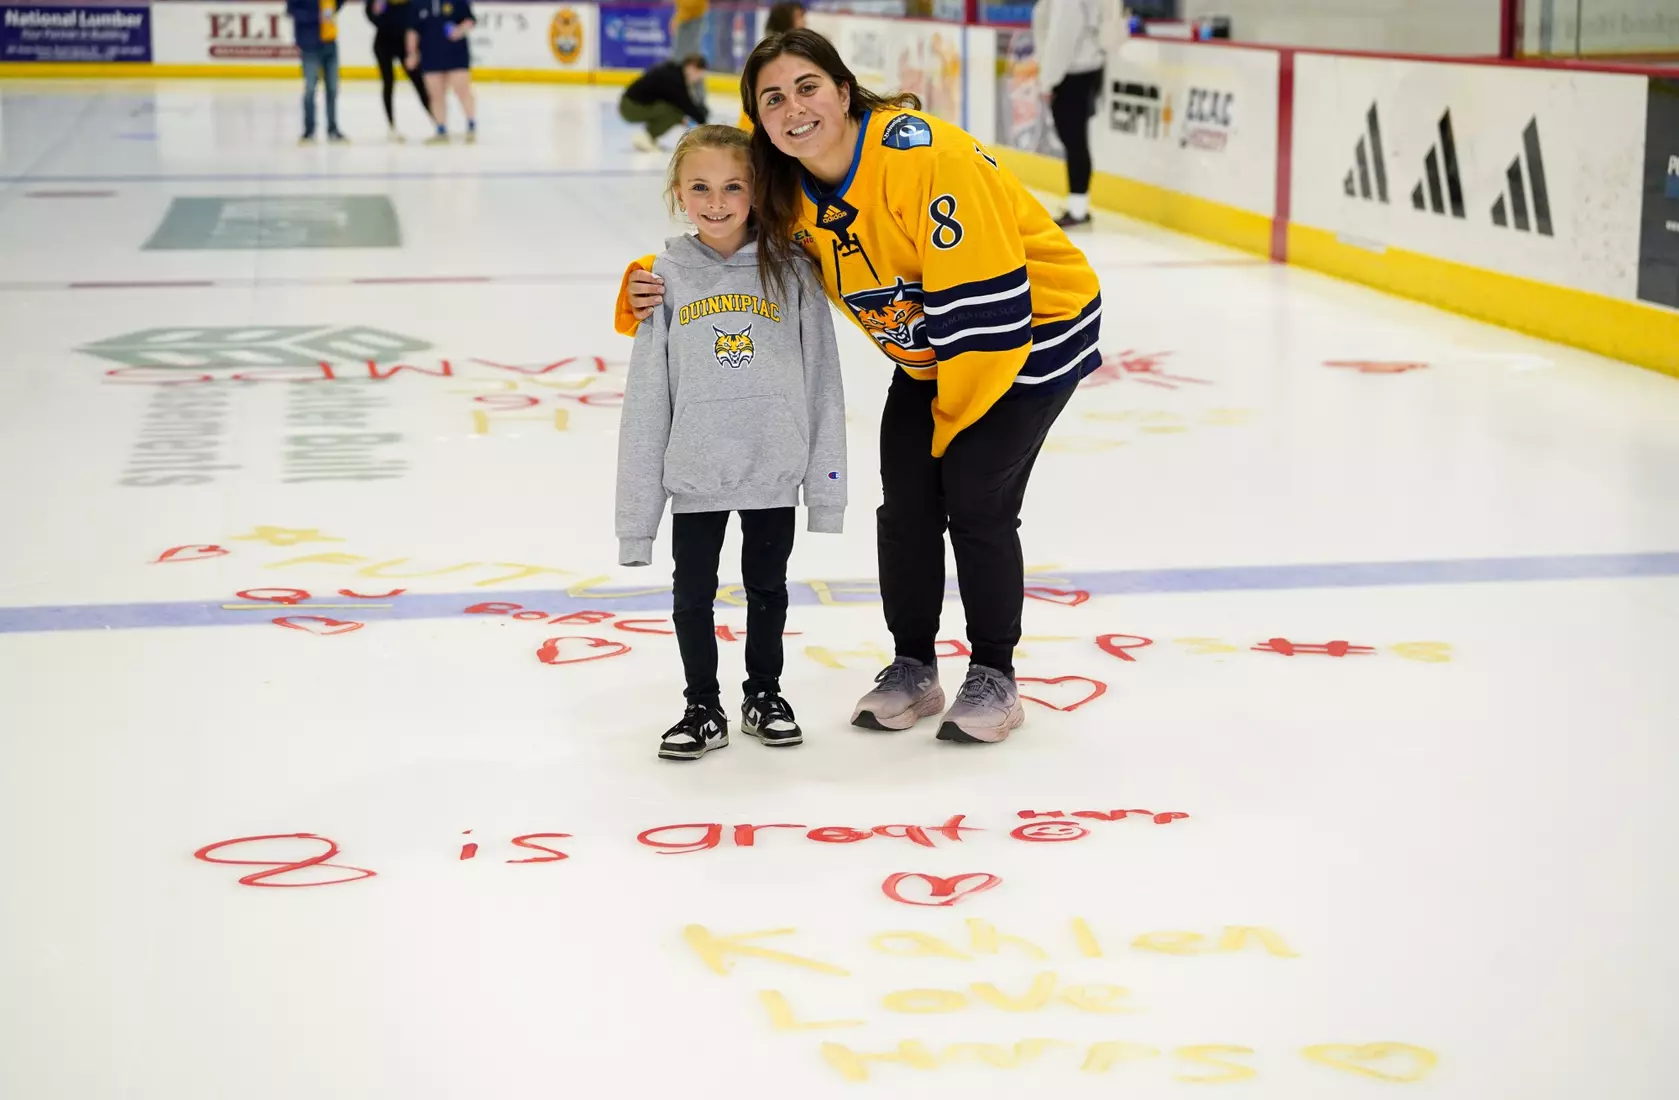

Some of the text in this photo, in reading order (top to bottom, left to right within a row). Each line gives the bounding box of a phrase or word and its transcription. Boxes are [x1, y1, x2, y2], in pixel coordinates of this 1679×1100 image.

[4, 9, 143, 28] National Lumber
[822, 210, 848, 224] adidas
[928, 193, 965, 250] 8
[679, 293, 781, 326] QUINNIPIAC
[193, 814, 990, 888] 8 is great
[683, 917, 1301, 976] Kahlen
